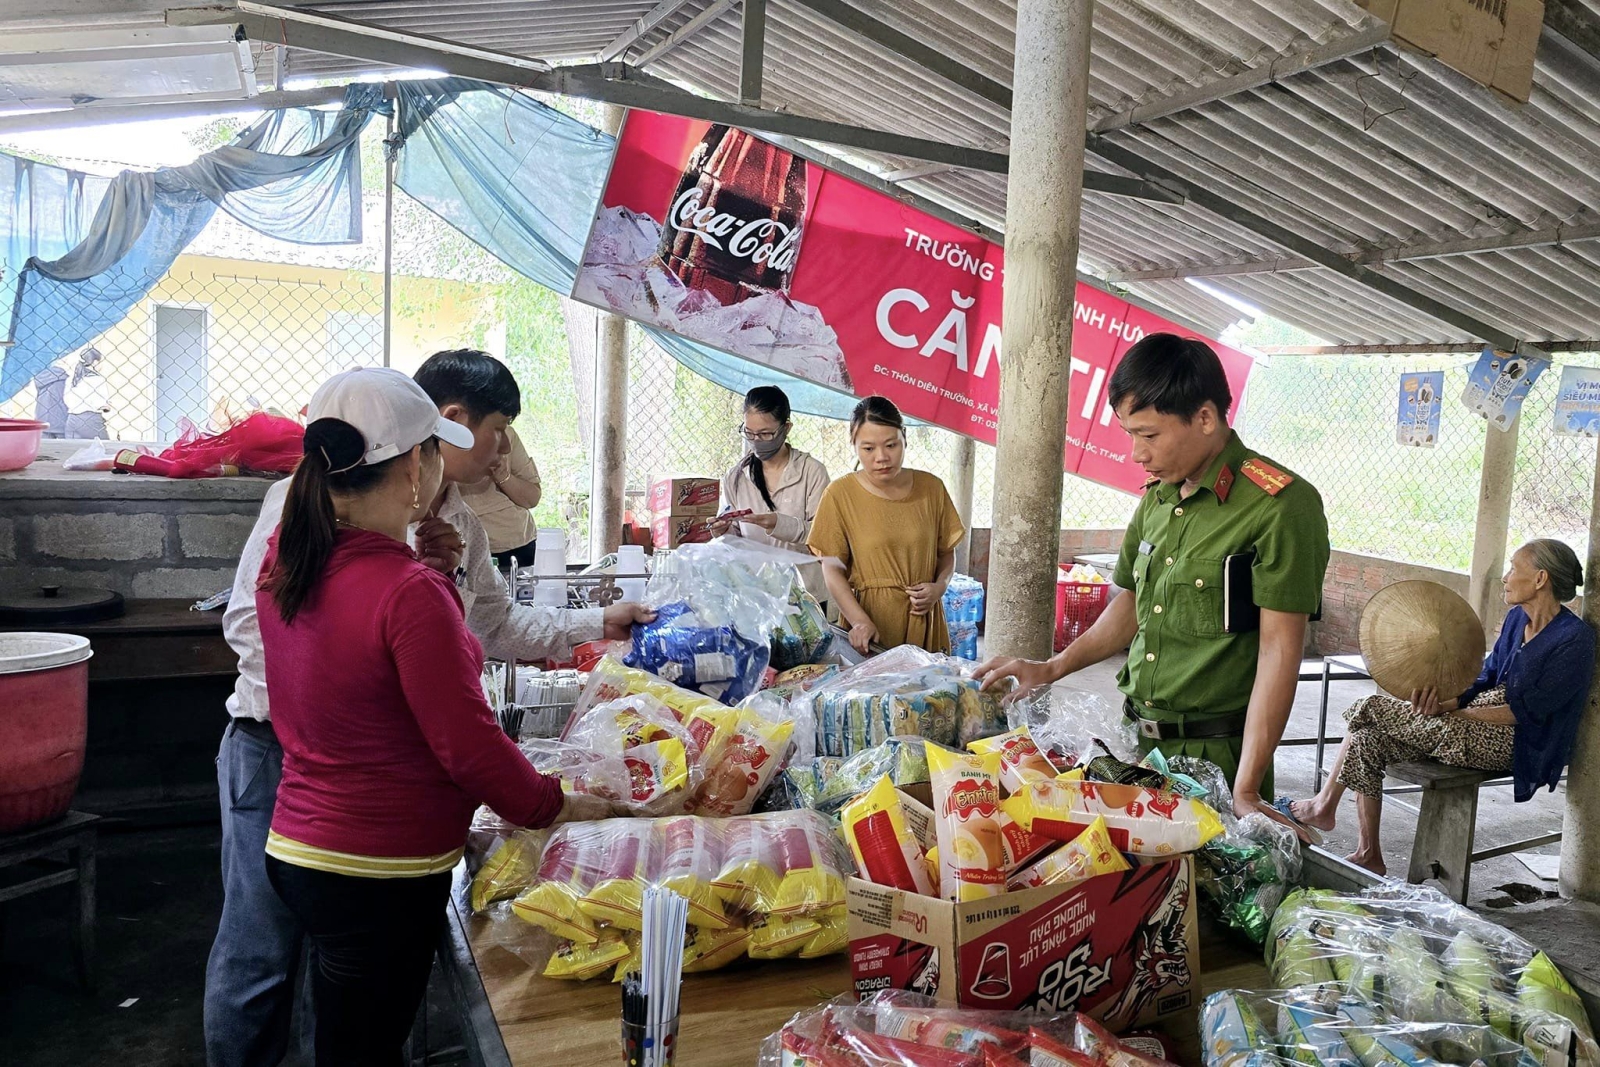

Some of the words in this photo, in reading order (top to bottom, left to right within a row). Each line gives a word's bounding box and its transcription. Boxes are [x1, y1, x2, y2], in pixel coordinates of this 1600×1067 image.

[670, 187, 801, 271] Coca-Cola
[904, 227, 995, 281] TRƯỜNG
[1072, 301, 1106, 329] INH
[1108, 318, 1151, 344] HƯN
[873, 364, 890, 376] ĐC:
[891, 370, 916, 386] THÔN
[855, 977, 891, 990] DRAGON
